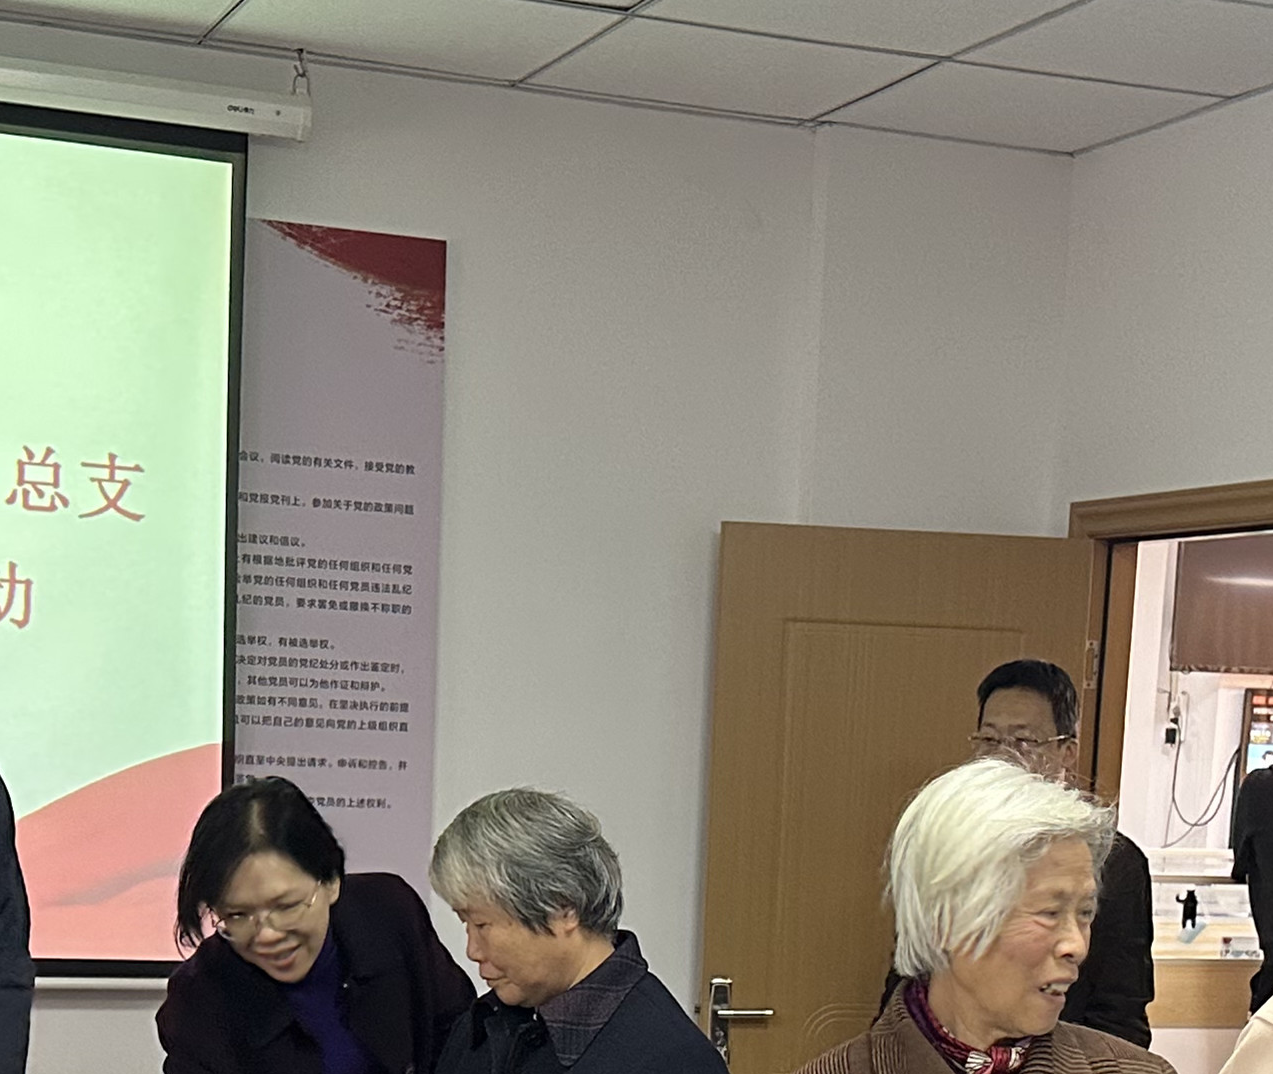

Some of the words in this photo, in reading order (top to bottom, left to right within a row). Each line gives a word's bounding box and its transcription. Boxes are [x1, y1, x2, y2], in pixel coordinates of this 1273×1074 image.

[237, 553, 413, 576] 有根据地批评党的任何组织和任何党
[236, 594, 412, 616] 纪的党员，要求罢免或撤换不称职的
